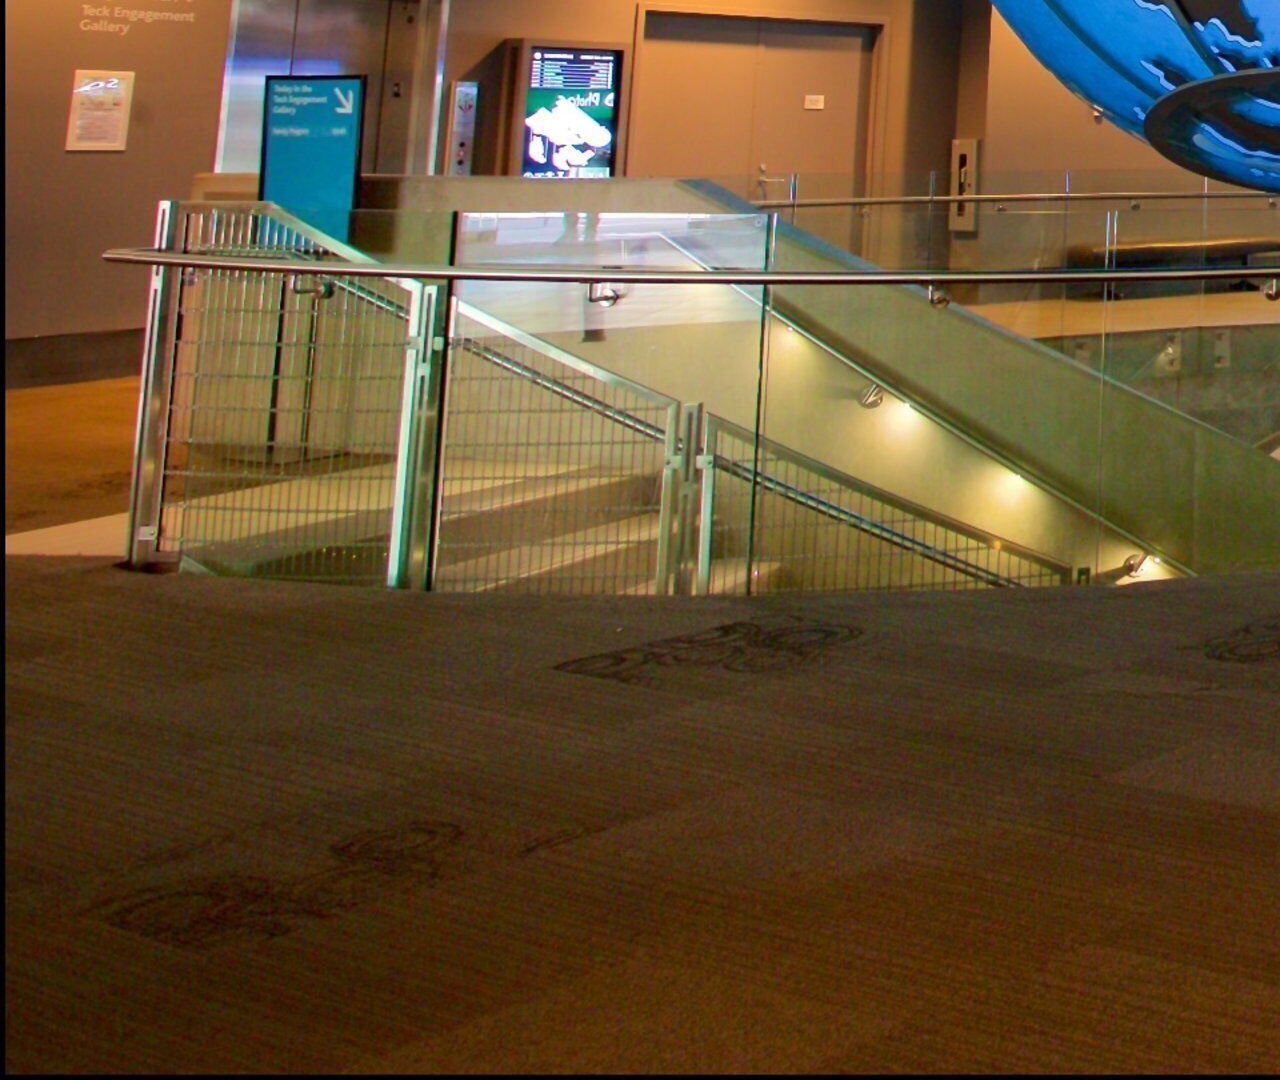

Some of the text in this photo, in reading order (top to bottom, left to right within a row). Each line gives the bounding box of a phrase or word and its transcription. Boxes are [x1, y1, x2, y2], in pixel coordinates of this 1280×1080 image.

[82, 4, 195, 23] Teck Engagement
[80, 19, 130, 36] Gallery
